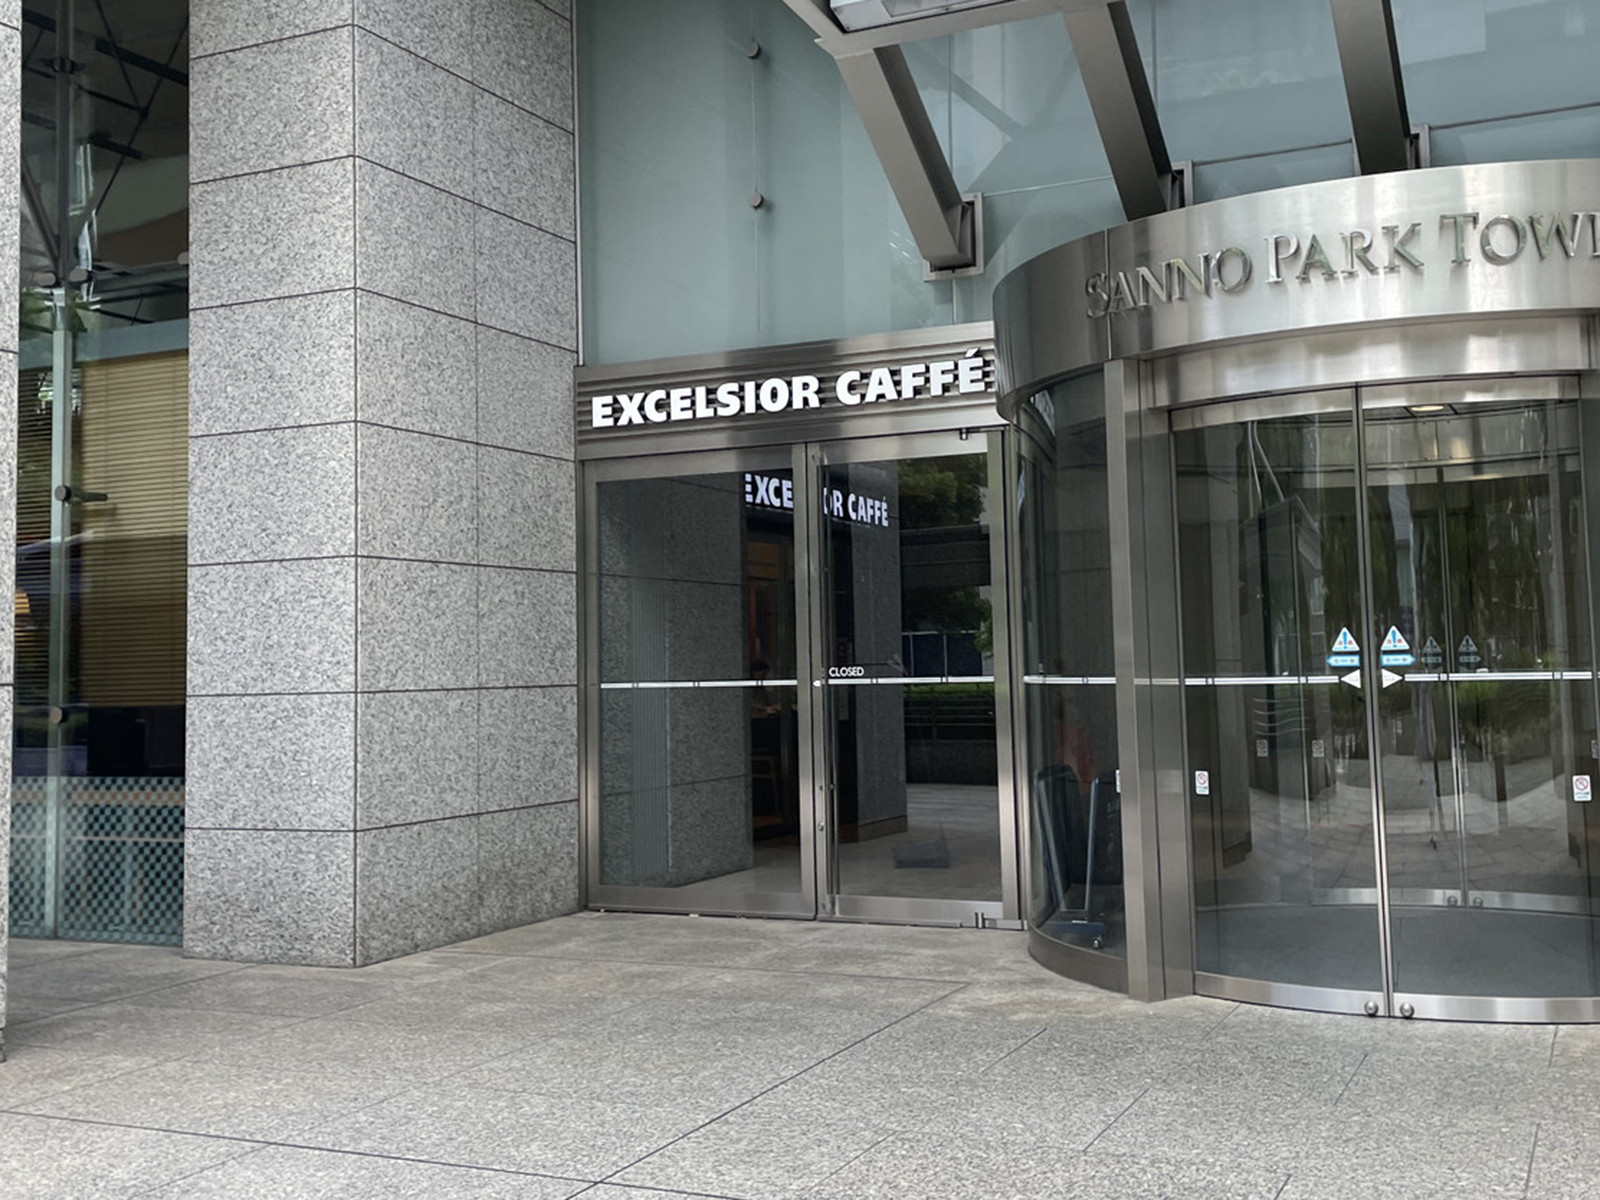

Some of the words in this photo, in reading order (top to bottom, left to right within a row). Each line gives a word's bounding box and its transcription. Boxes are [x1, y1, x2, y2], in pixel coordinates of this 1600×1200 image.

[1085, 247, 1252, 319] SANNO
[1264, 222, 1425, 285] PARK
[591, 374, 820, 429] EXCELSIOR
[835, 347, 986, 406] CAFFÉ
[828, 666, 865, 678] CLOSED
